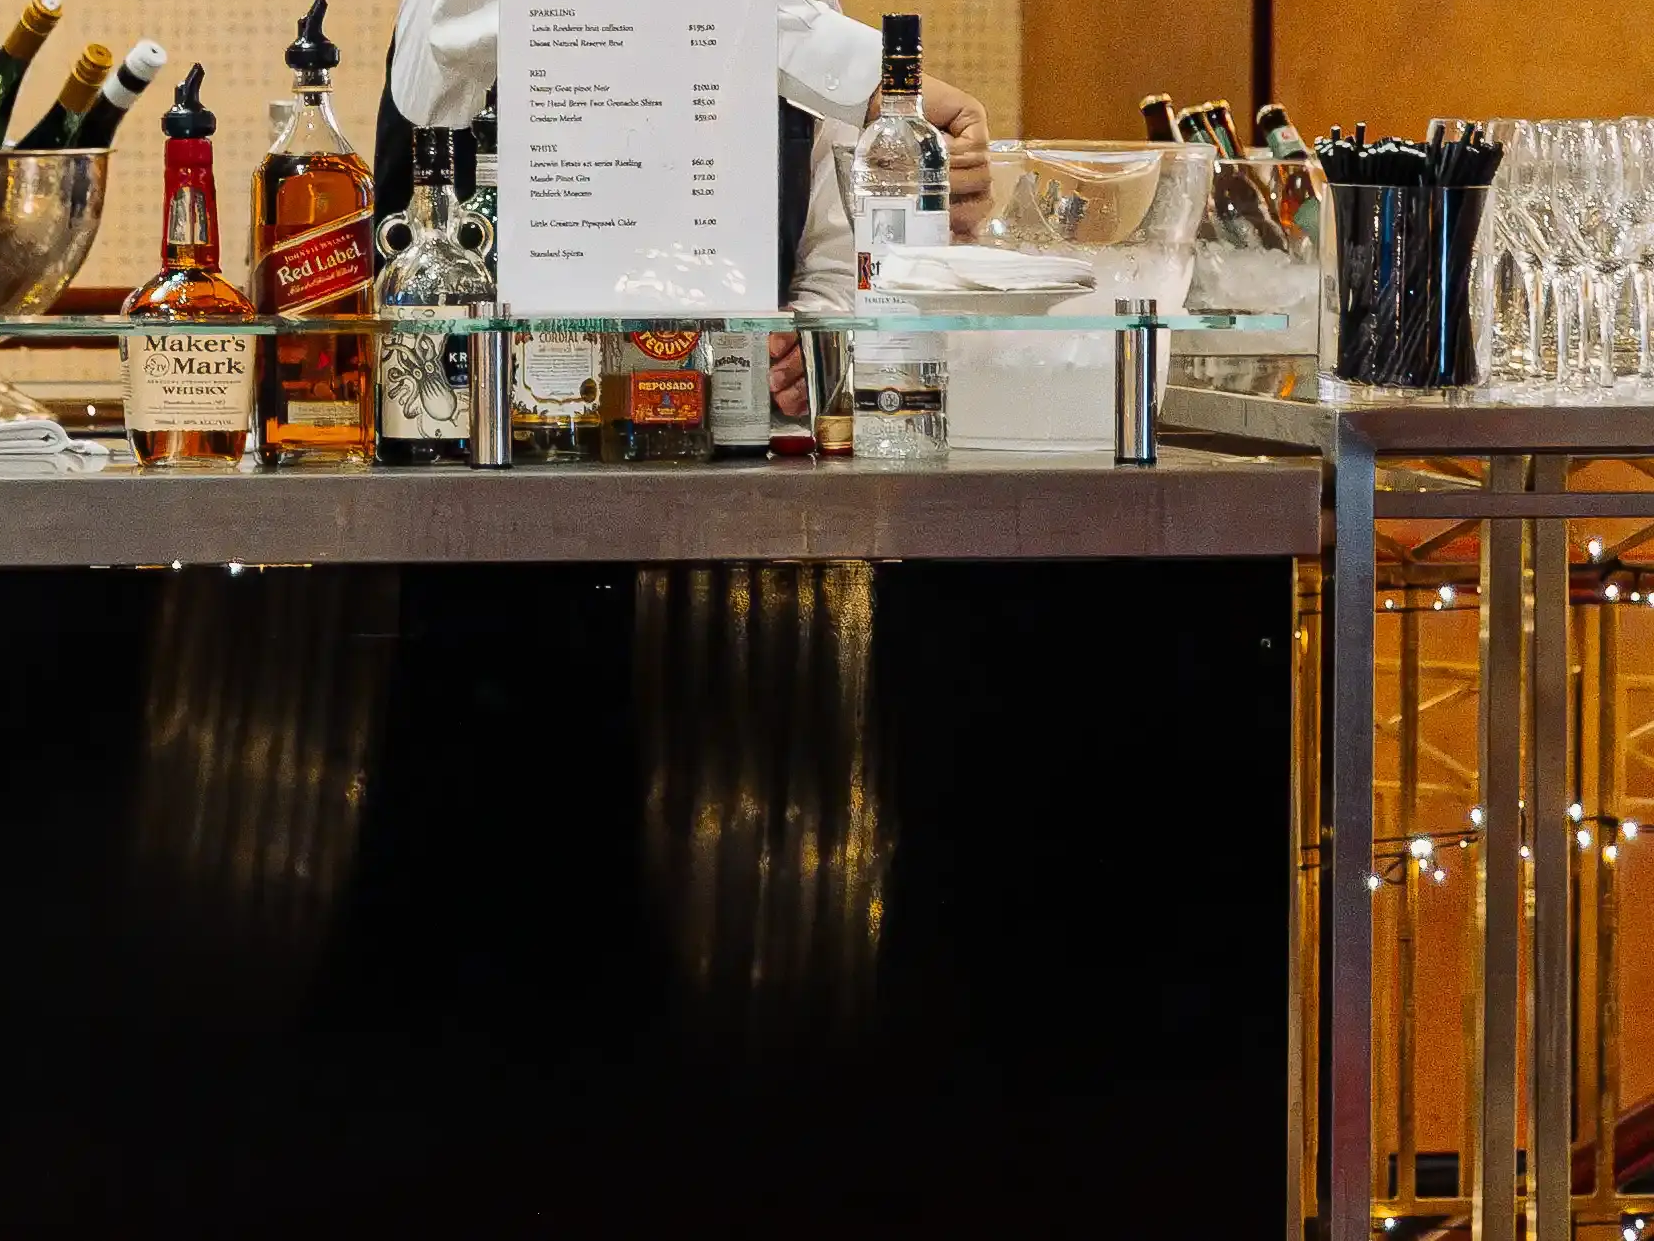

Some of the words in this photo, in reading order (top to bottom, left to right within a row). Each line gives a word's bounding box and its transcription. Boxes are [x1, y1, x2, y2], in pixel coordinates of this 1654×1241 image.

[529, 8, 576, 17] SPARKLING
[529, 69, 546, 77] RED
[529, 144, 558, 153] WHITE
[276, 259, 314, 286] Red
[315, 240, 364, 272] Label
[538, 331, 579, 343] CORDIAL
[143, 334, 246, 352] Maker's
[639, 330, 697, 356] TEQUILA
[171, 357, 244, 375] Mark
[162, 386, 228, 396] WHISKY
[638, 381, 695, 391] REPOSADO
